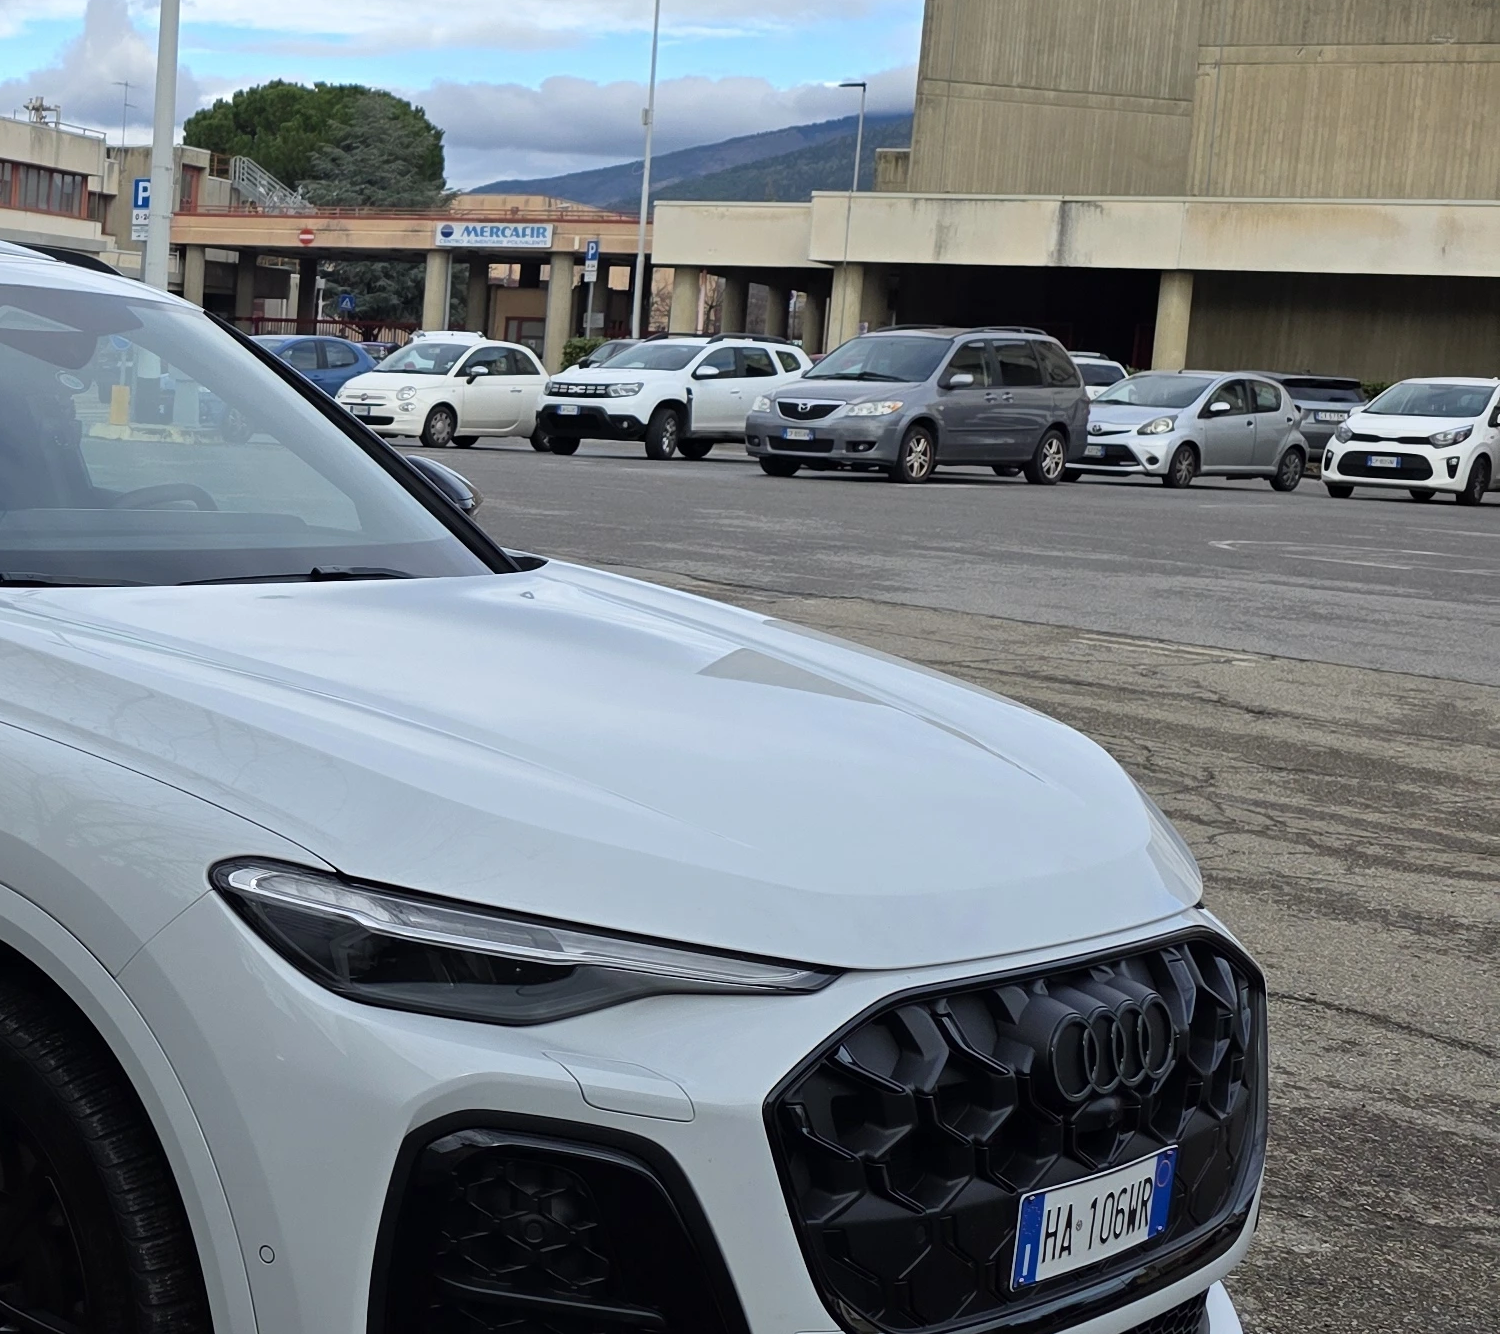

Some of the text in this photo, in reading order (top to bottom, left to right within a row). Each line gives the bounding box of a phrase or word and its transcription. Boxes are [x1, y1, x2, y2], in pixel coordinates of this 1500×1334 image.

[138, 181, 151, 206] P
[460, 225, 548, 239] MERCAFIR
[588, 242, 597, 259] P
[1041, 1203, 1073, 1264] HA
[1087, 1176, 1154, 1251] 106WR
